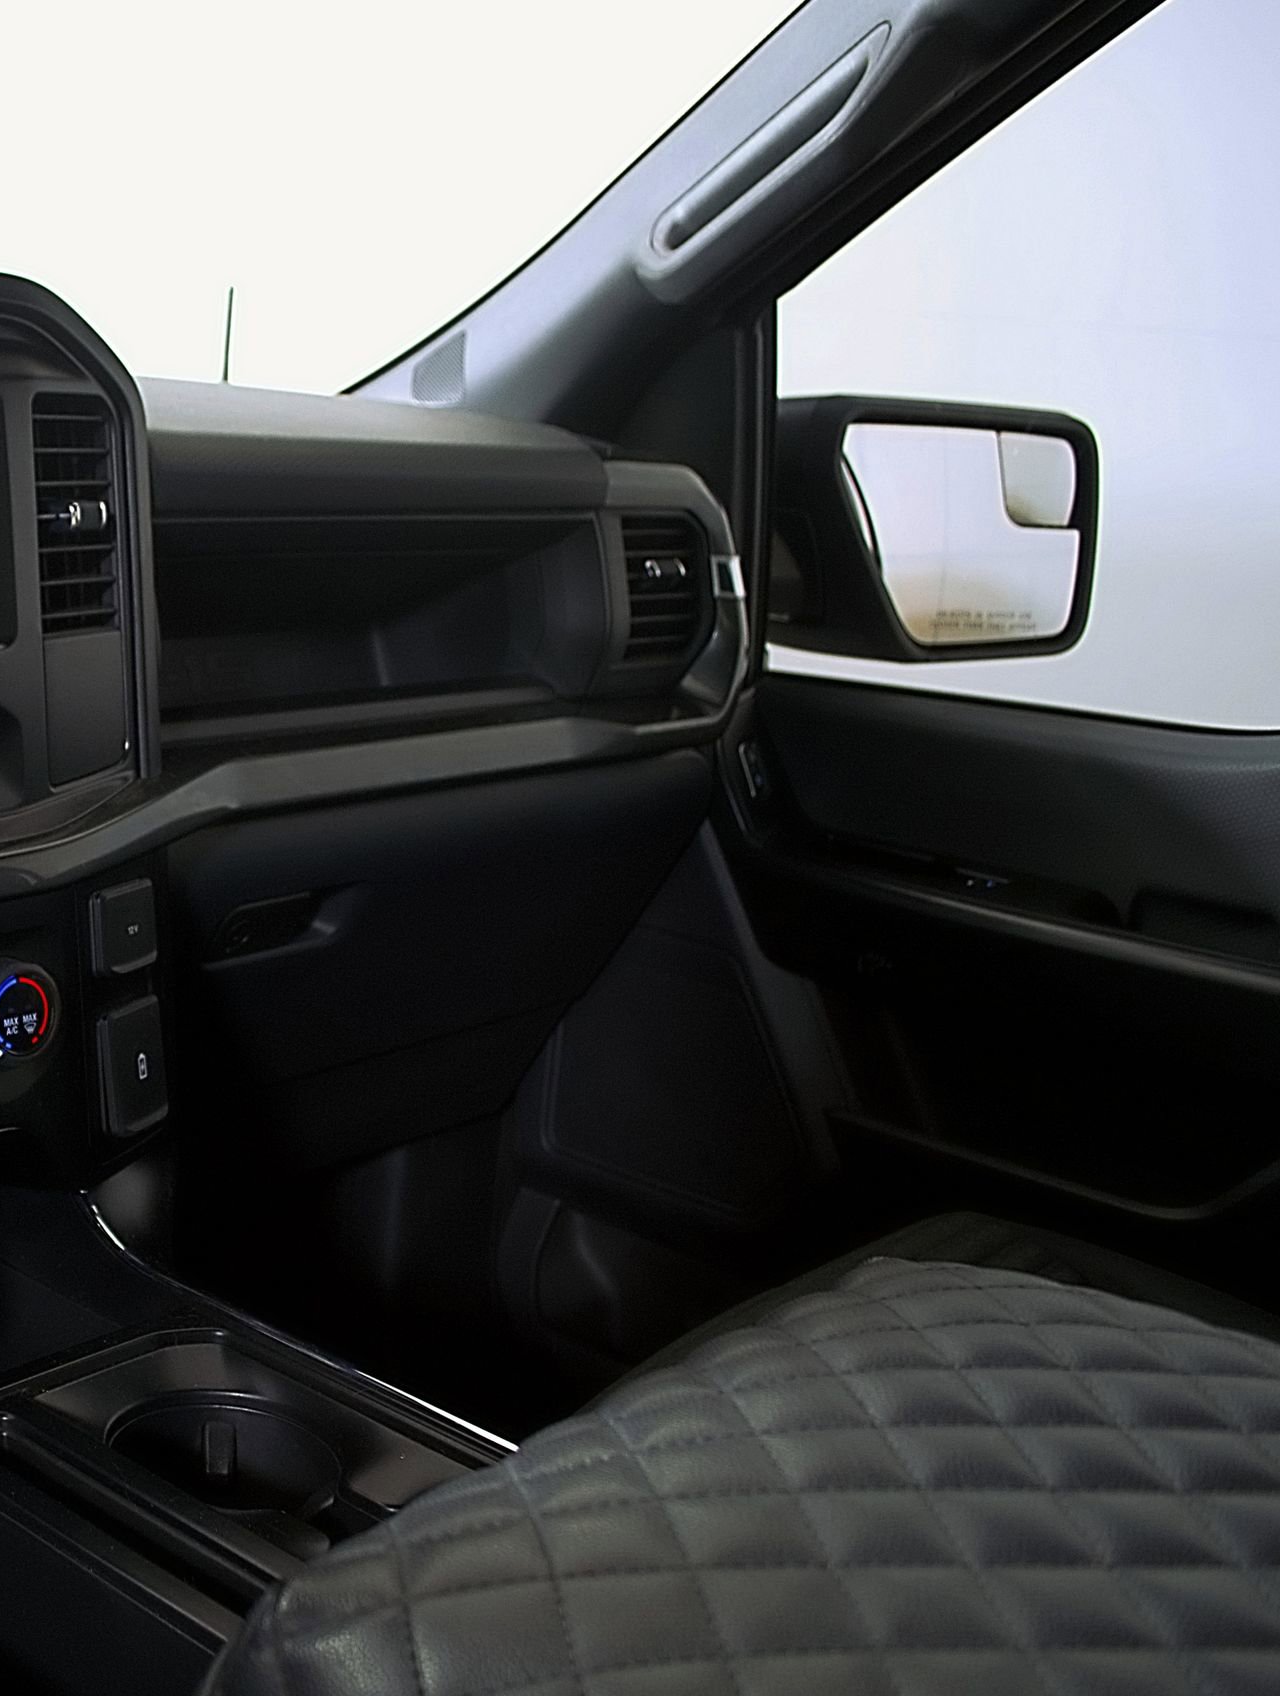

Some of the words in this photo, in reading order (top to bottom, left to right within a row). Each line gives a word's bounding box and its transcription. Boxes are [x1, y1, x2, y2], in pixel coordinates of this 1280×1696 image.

[3, 1016, 19, 1028] MAX
[22, 1012, 38, 1023] MAX
[6, 1026, 19, 1036] A/C
